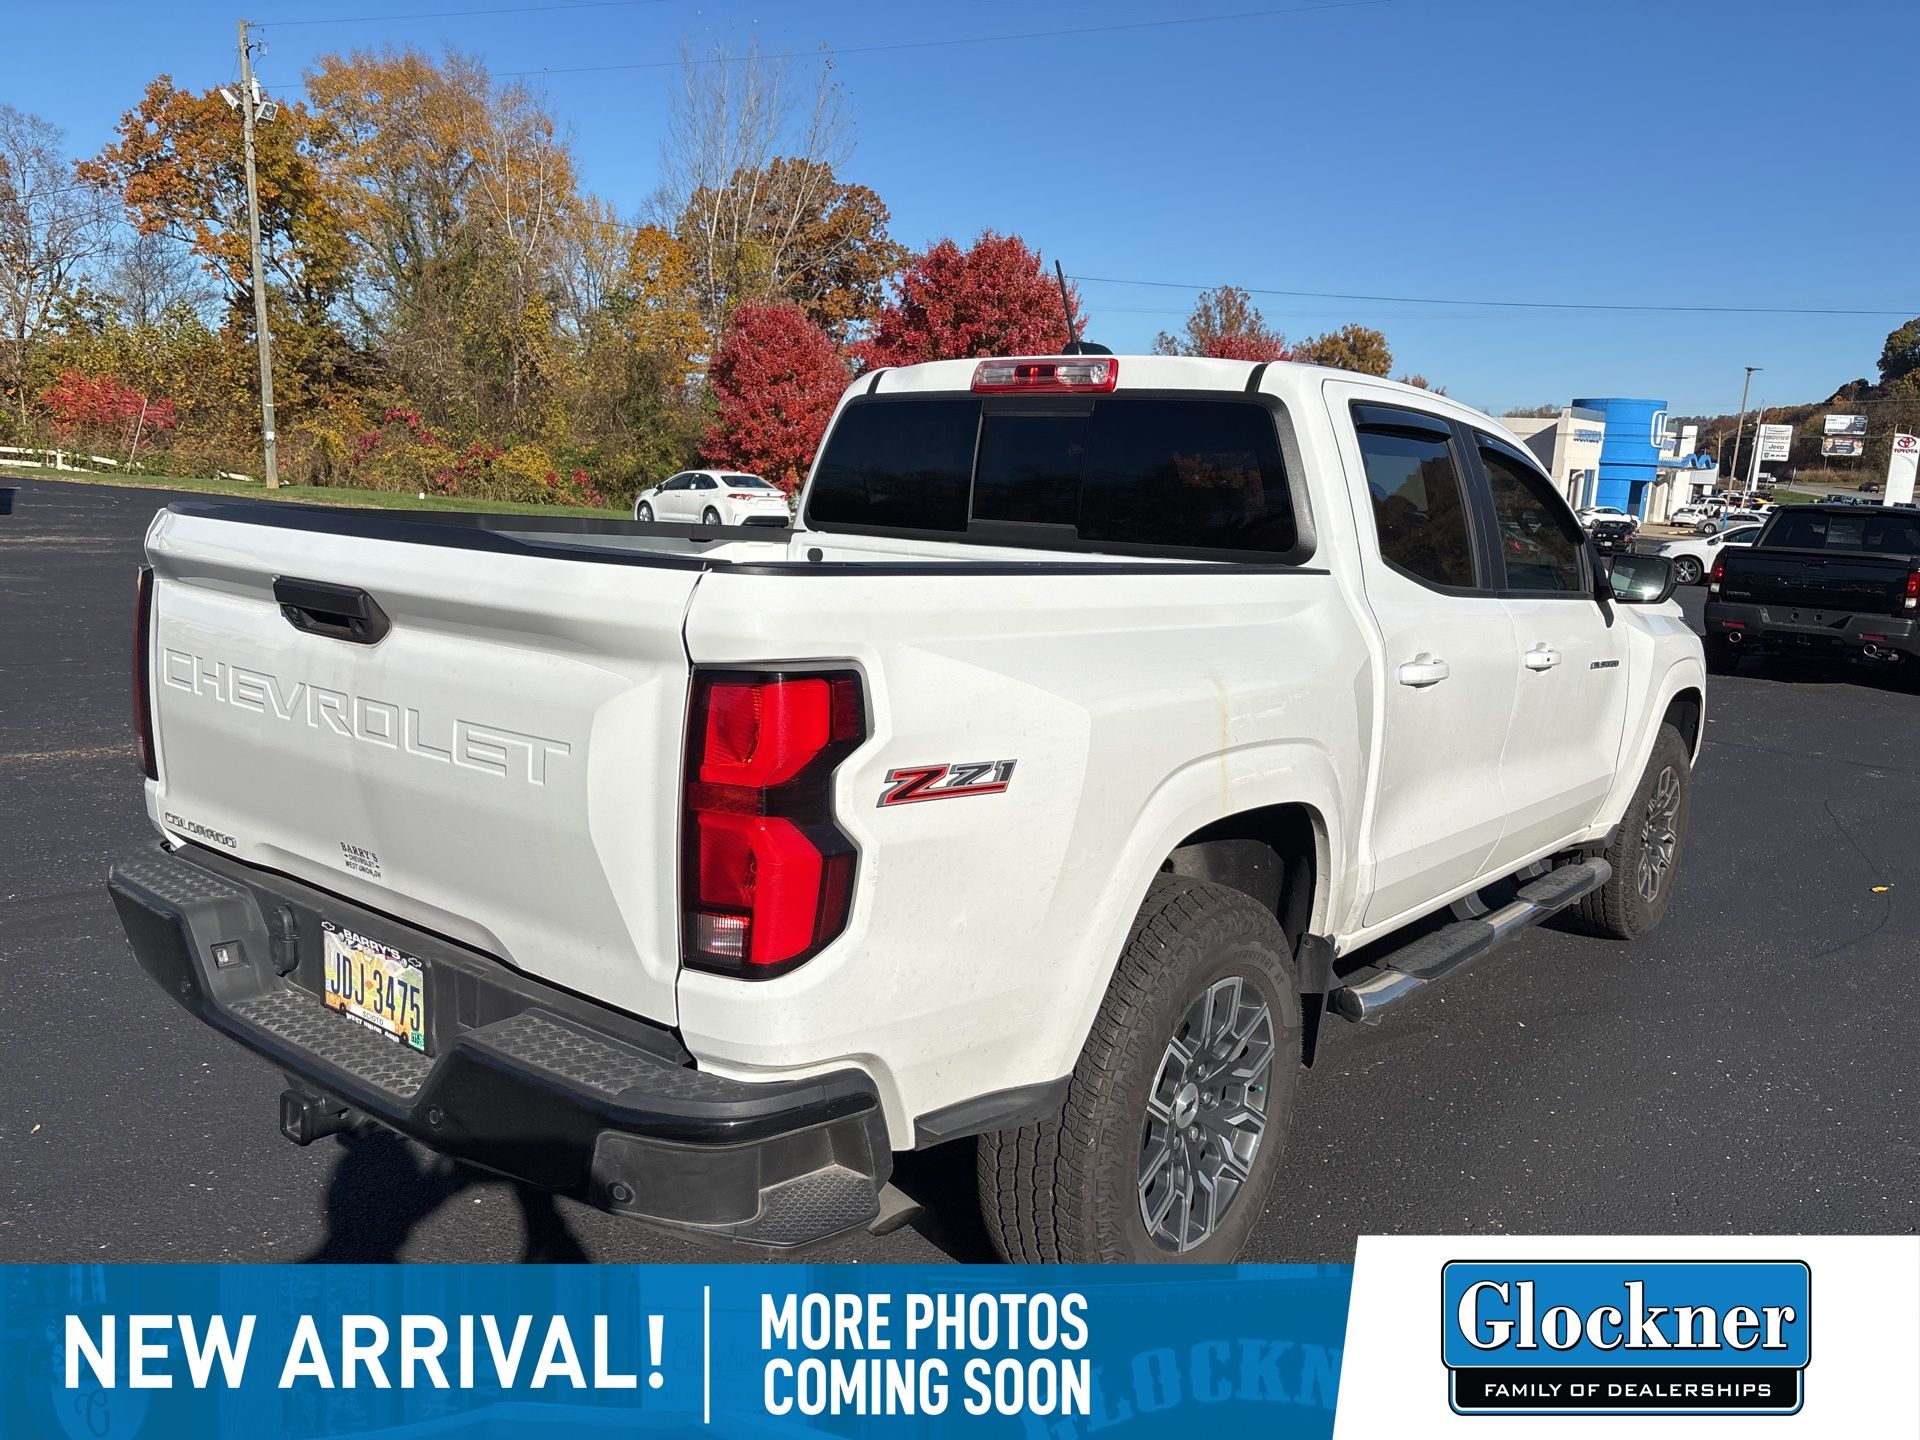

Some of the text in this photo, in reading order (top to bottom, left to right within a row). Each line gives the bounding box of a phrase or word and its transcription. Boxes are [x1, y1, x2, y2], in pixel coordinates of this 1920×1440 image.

[163, 647, 571, 786] CHEVROLET
[165, 812, 237, 848] COLORADO
[340, 841, 379, 863] BARRY'S
[343, 928, 401, 960] BARRY'S
[331, 952, 421, 1032] JDJ 3475
[362, 1011, 384, 1026] SCIOTO
